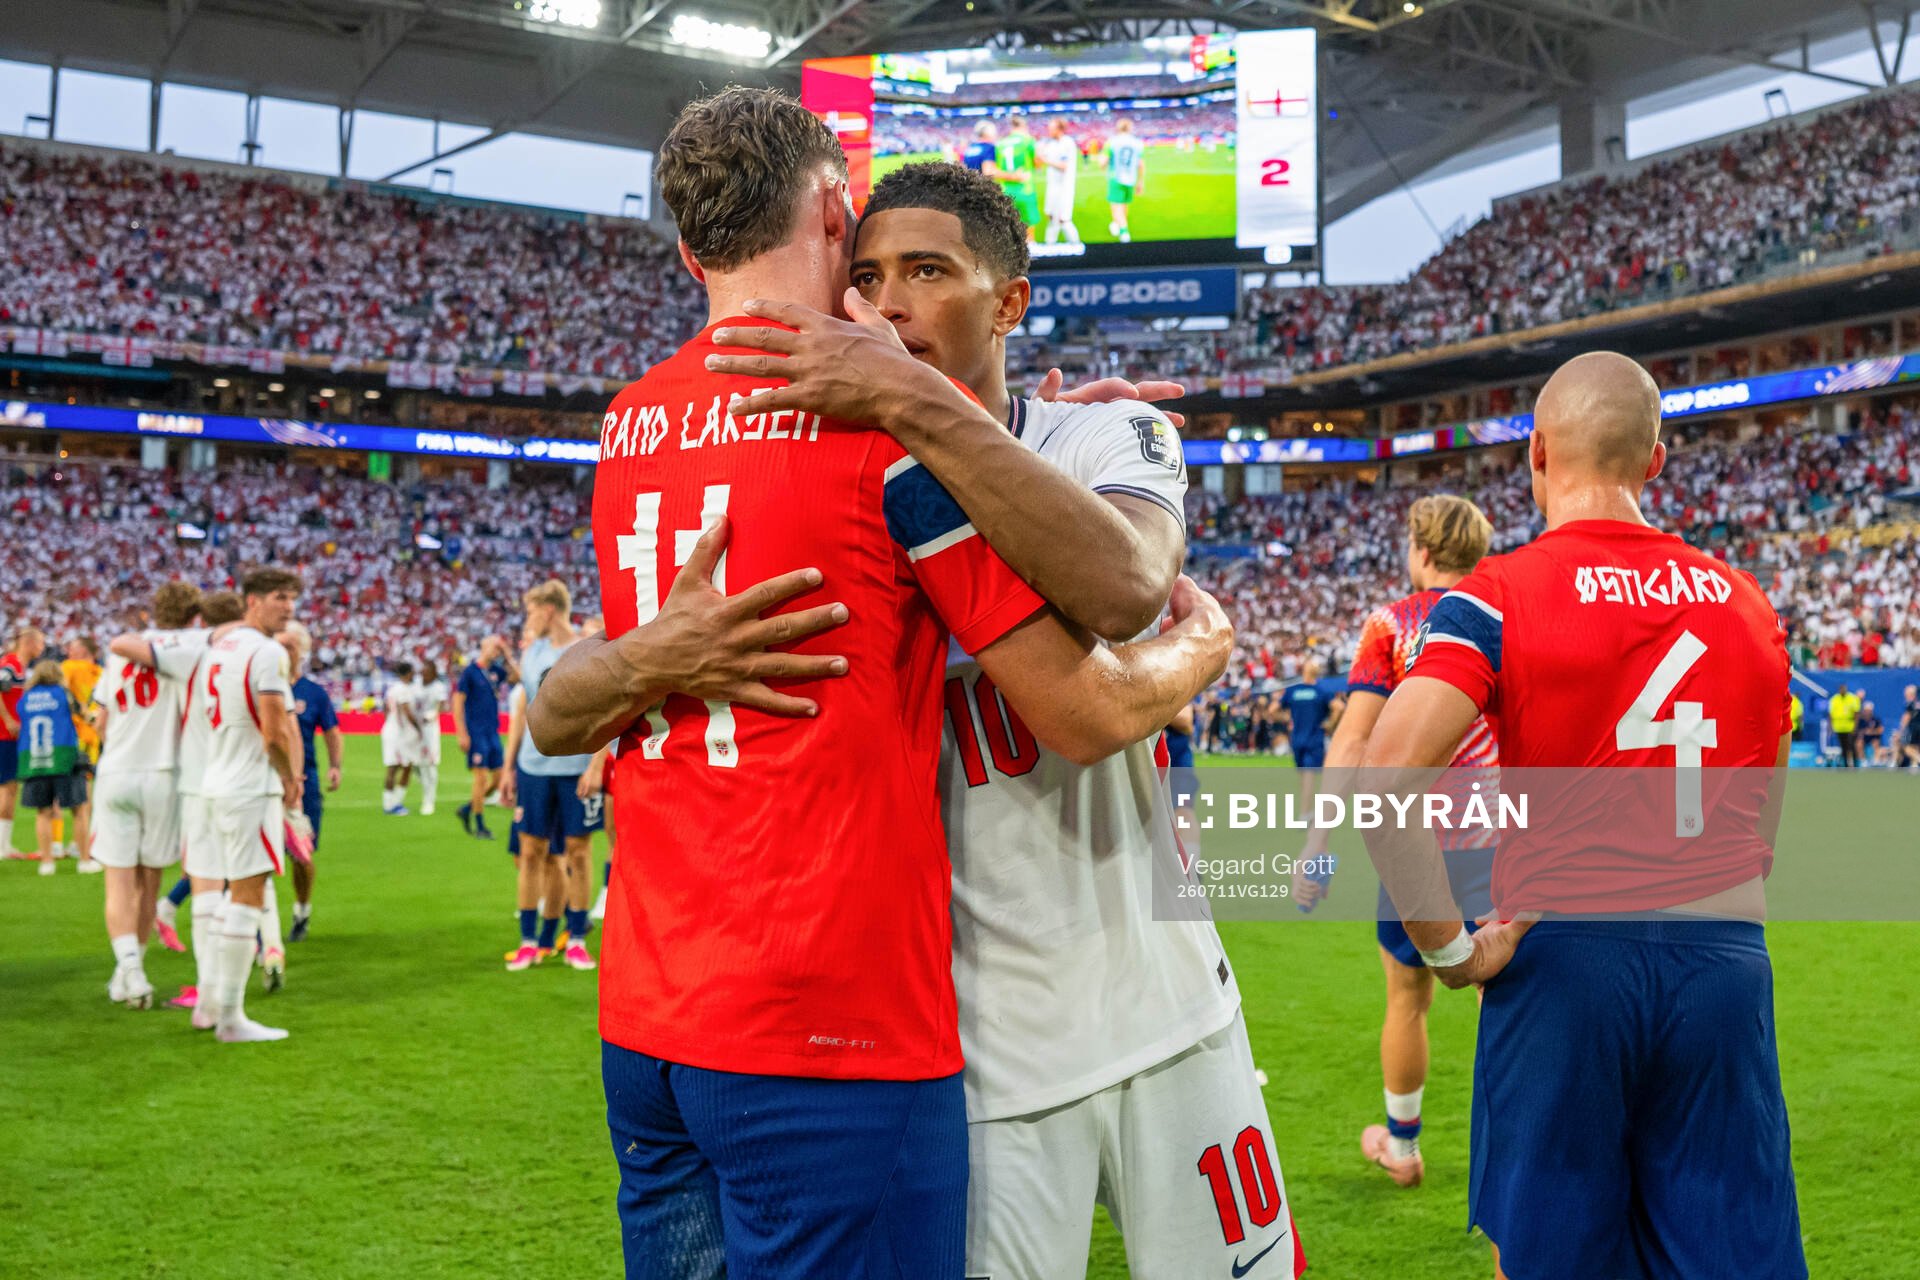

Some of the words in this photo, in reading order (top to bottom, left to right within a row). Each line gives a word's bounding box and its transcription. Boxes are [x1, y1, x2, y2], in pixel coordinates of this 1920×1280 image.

[1260, 158, 1291, 186] 2
[1055, 283, 1108, 307] CUP
[1109, 279, 1202, 305] 2026
[1575, 559, 1732, 607] ØSTIGÅRD
[943, 670, 1040, 788] 10
[1616, 629, 1718, 838] 4
[1197, 1125, 1281, 1246] 10
